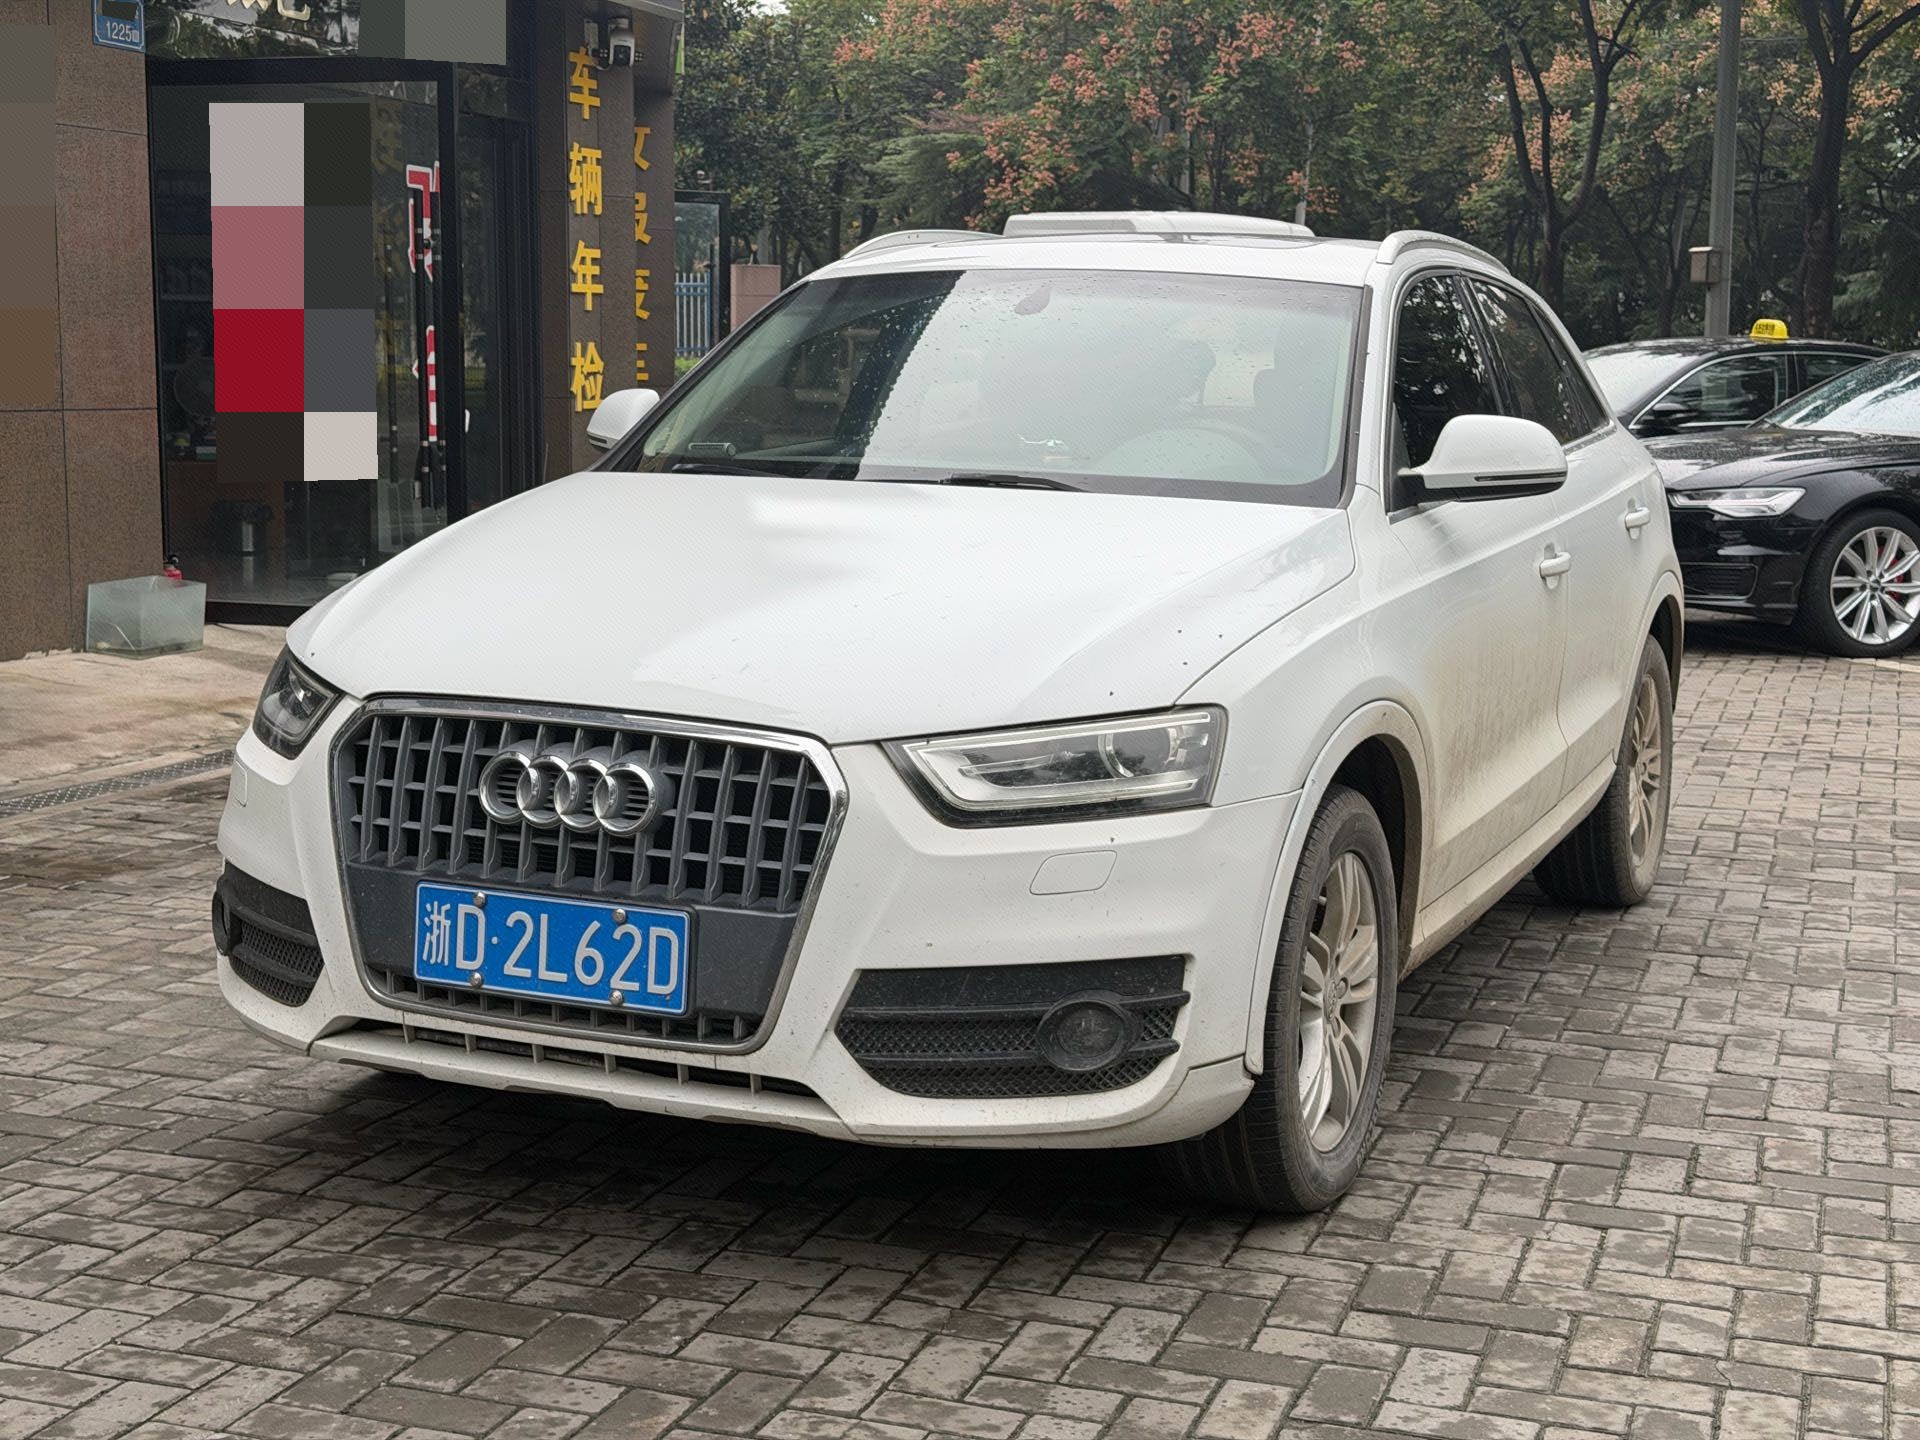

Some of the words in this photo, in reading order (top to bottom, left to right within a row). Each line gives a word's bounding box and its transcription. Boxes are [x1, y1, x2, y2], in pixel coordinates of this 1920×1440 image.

[568, 45, 604, 413] 车辆年检
[422, 900, 679, 995] 浙D·2L62D
